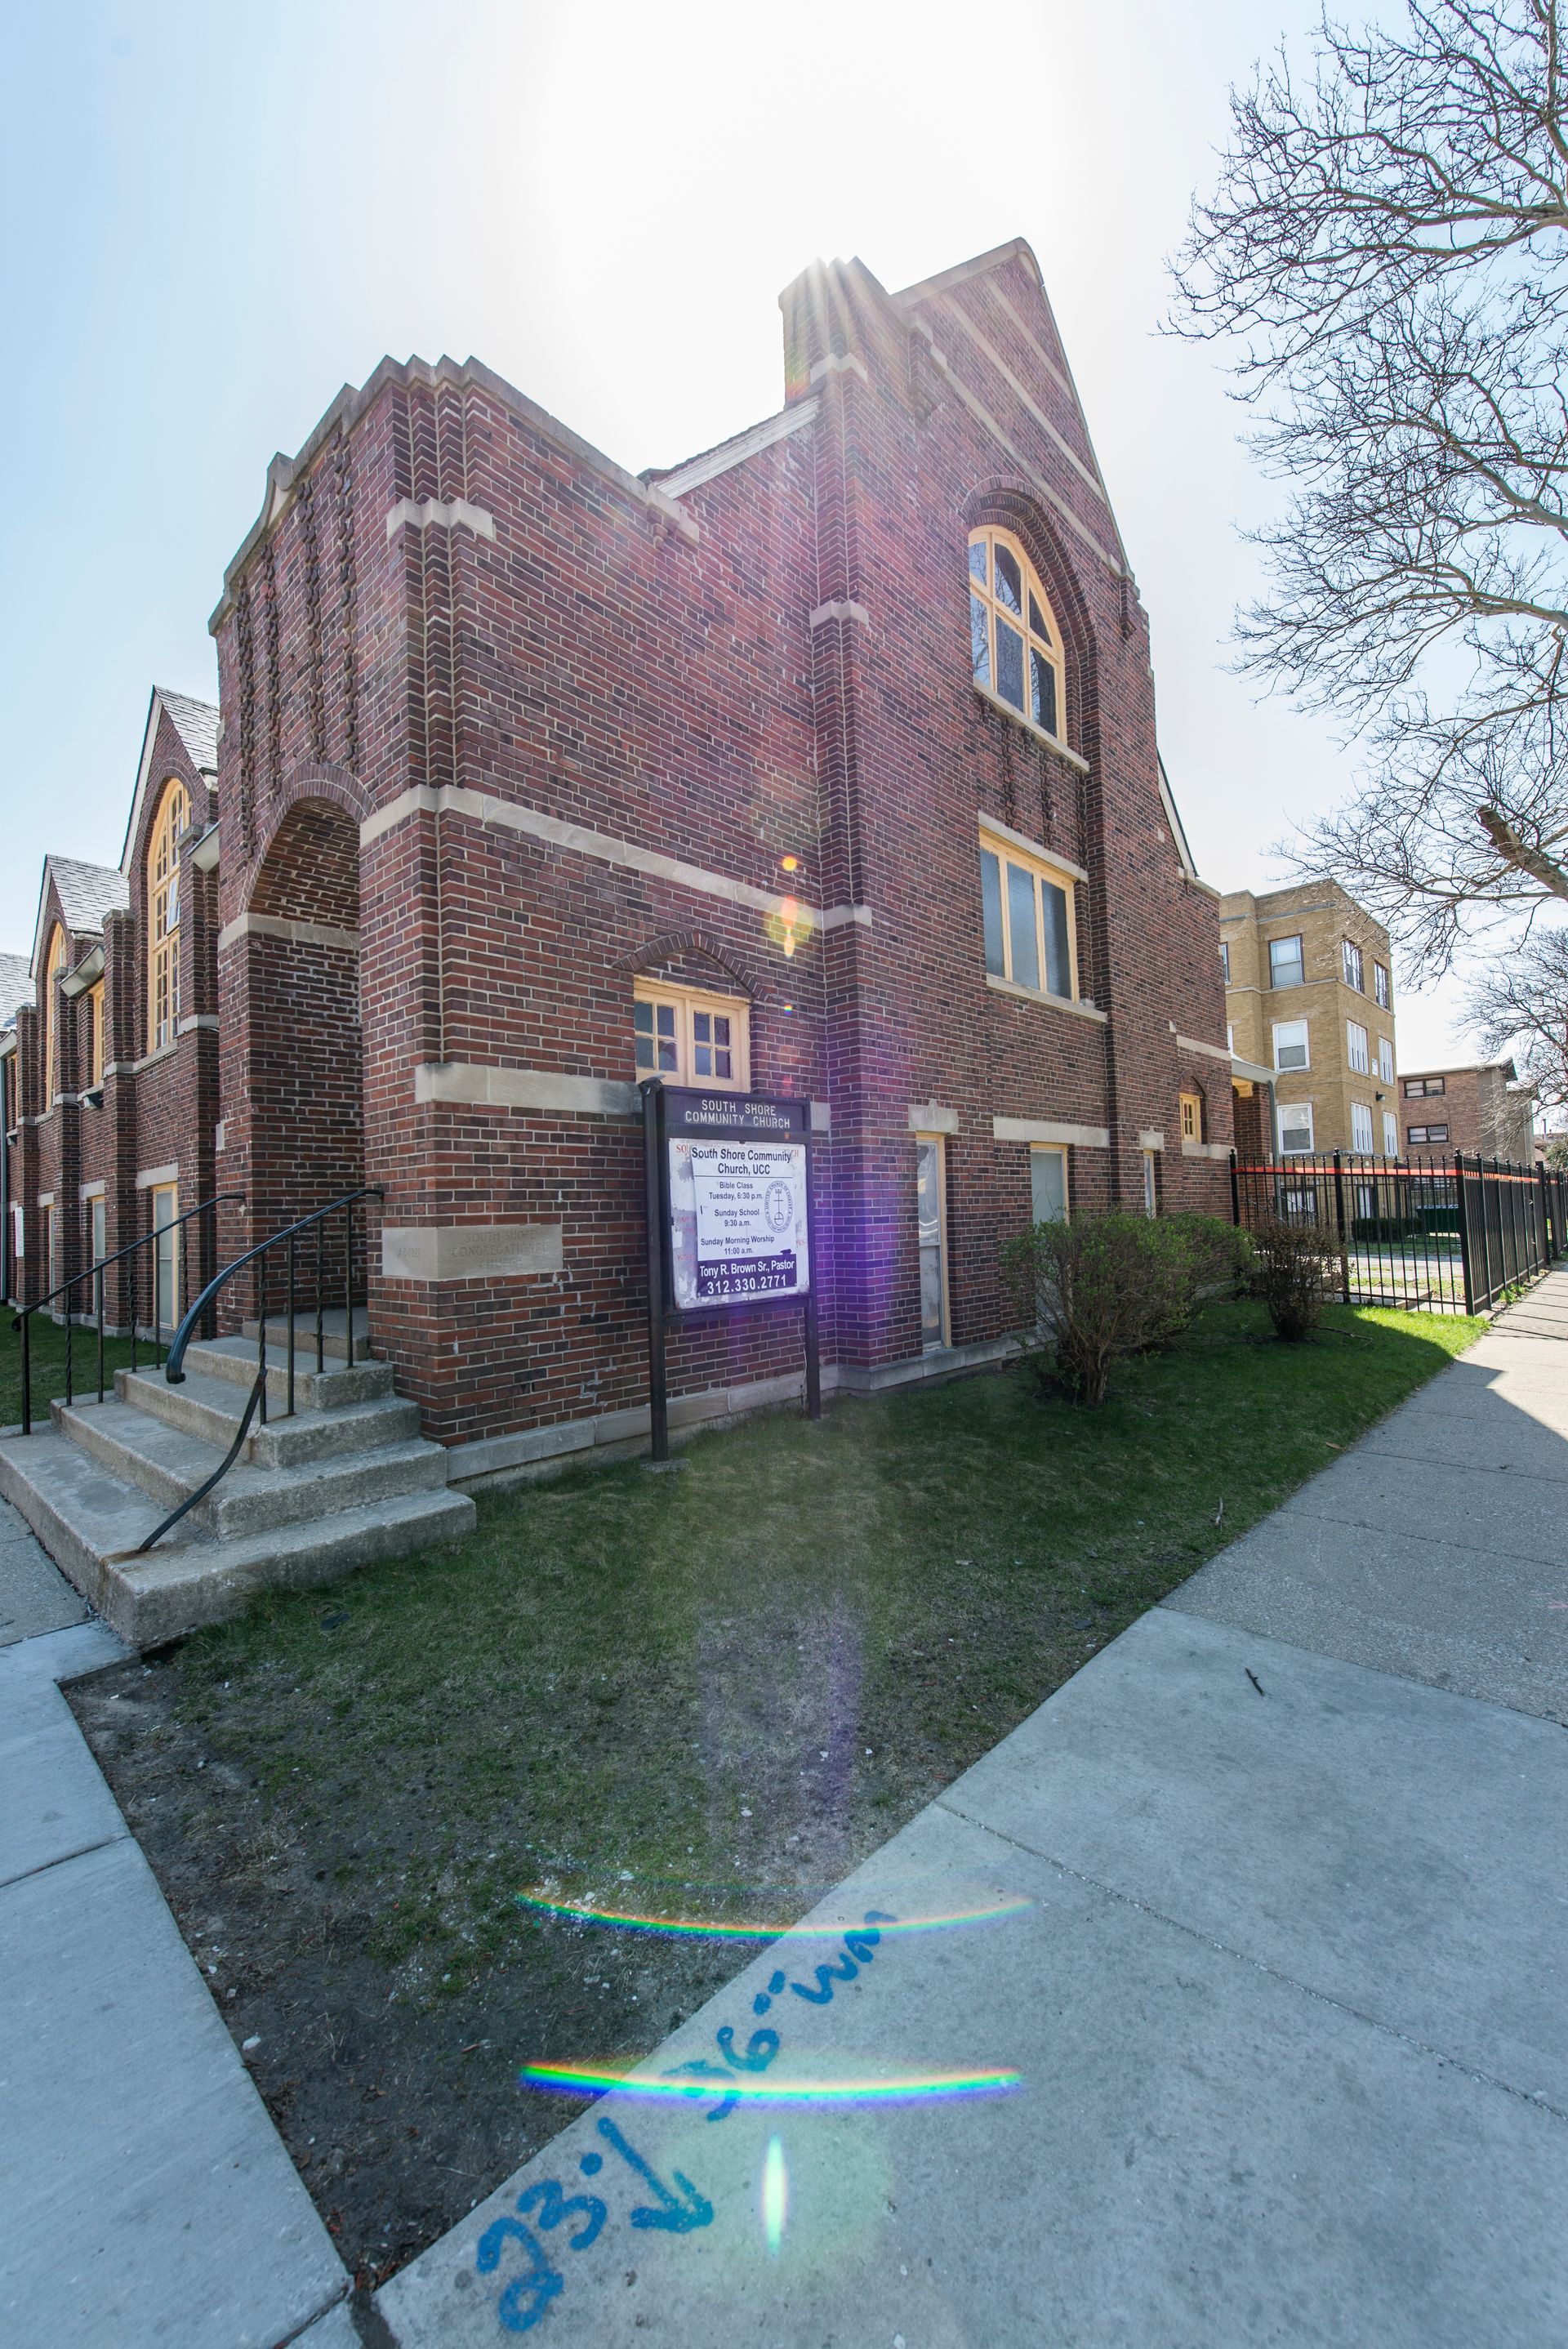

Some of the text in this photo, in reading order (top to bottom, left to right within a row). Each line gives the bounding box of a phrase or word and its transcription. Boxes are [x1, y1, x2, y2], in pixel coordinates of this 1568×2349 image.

[702, 1099, 776, 1116] SOUTH SHORE
[685, 1111, 791, 1129] COMMUNITY CHURCH
[692, 1147, 718, 1159] South
[720, 1148, 745, 1160] Shore
[747, 1149, 791, 1164] Community
[718, 1163, 770, 1176] Church, UCC
[708, 1192, 736, 1201] Tuesday,
[714, 1208, 760, 1218] Sunday School
[466, 1230, 537, 1243] SOUTH SHORE
[701, 1235, 775, 1246] Sunday Morning Worship
[700, 1259, 795, 1278] Tony R. Brown Sr., Pastor
[707, 1275, 786, 1294] 312.330.2771
